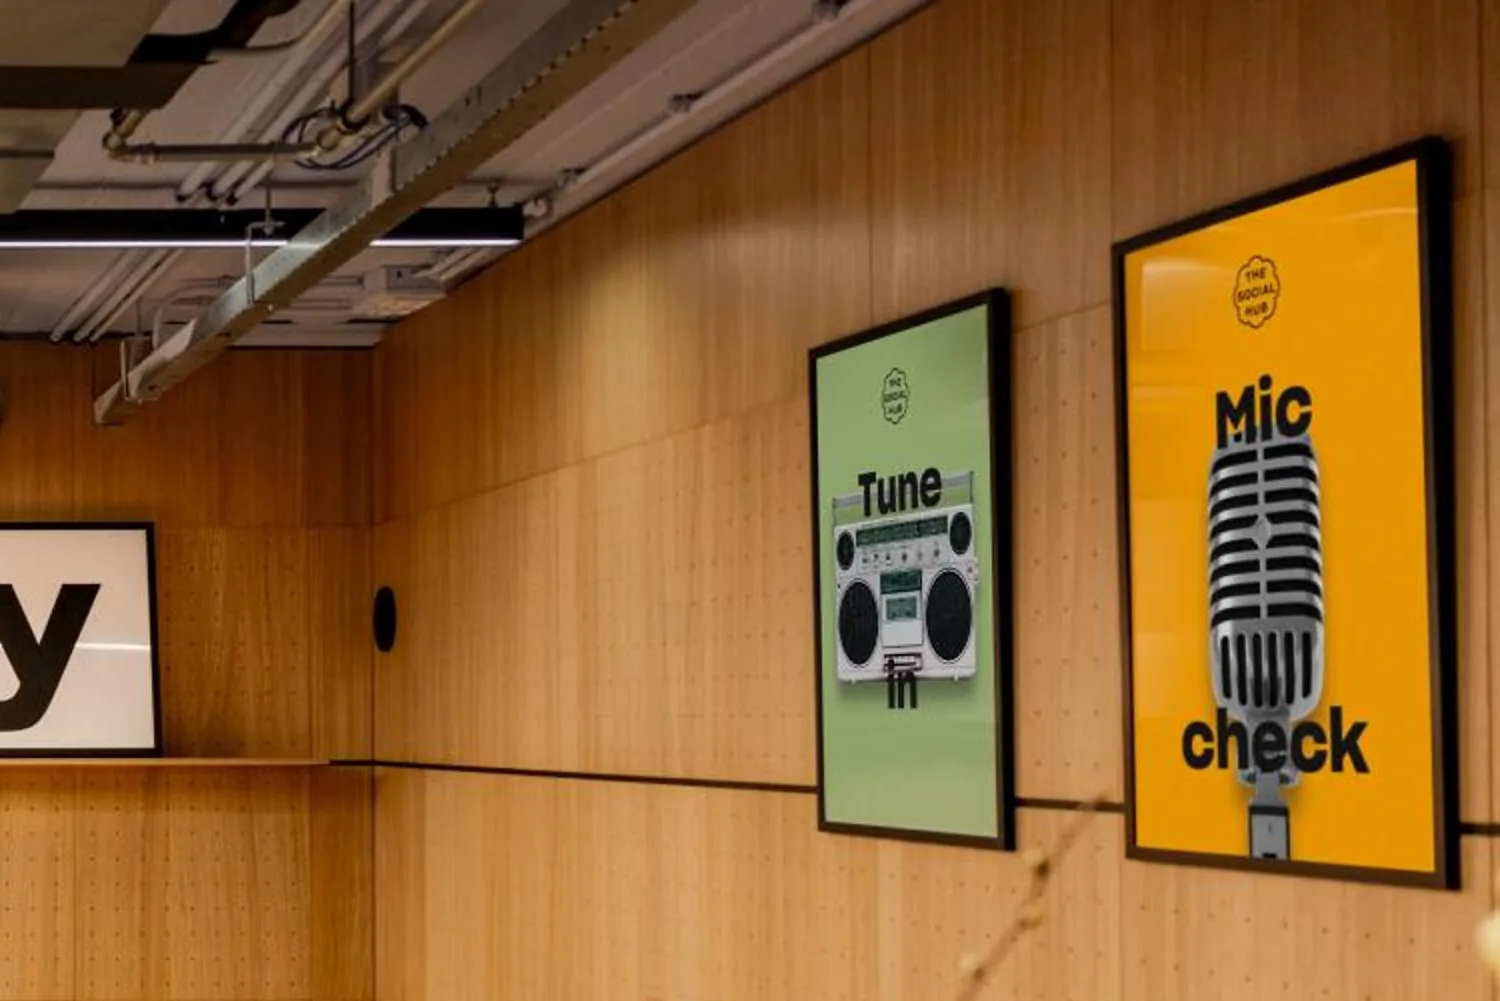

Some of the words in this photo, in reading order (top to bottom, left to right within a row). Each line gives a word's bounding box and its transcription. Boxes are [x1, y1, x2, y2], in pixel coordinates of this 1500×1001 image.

[1245, 267, 1266, 282] THE
[1216, 373, 1312, 449] Mic
[858, 467, 942, 517] Tune
[887, 658, 917, 709] in
[1182, 705, 1369, 773] check
